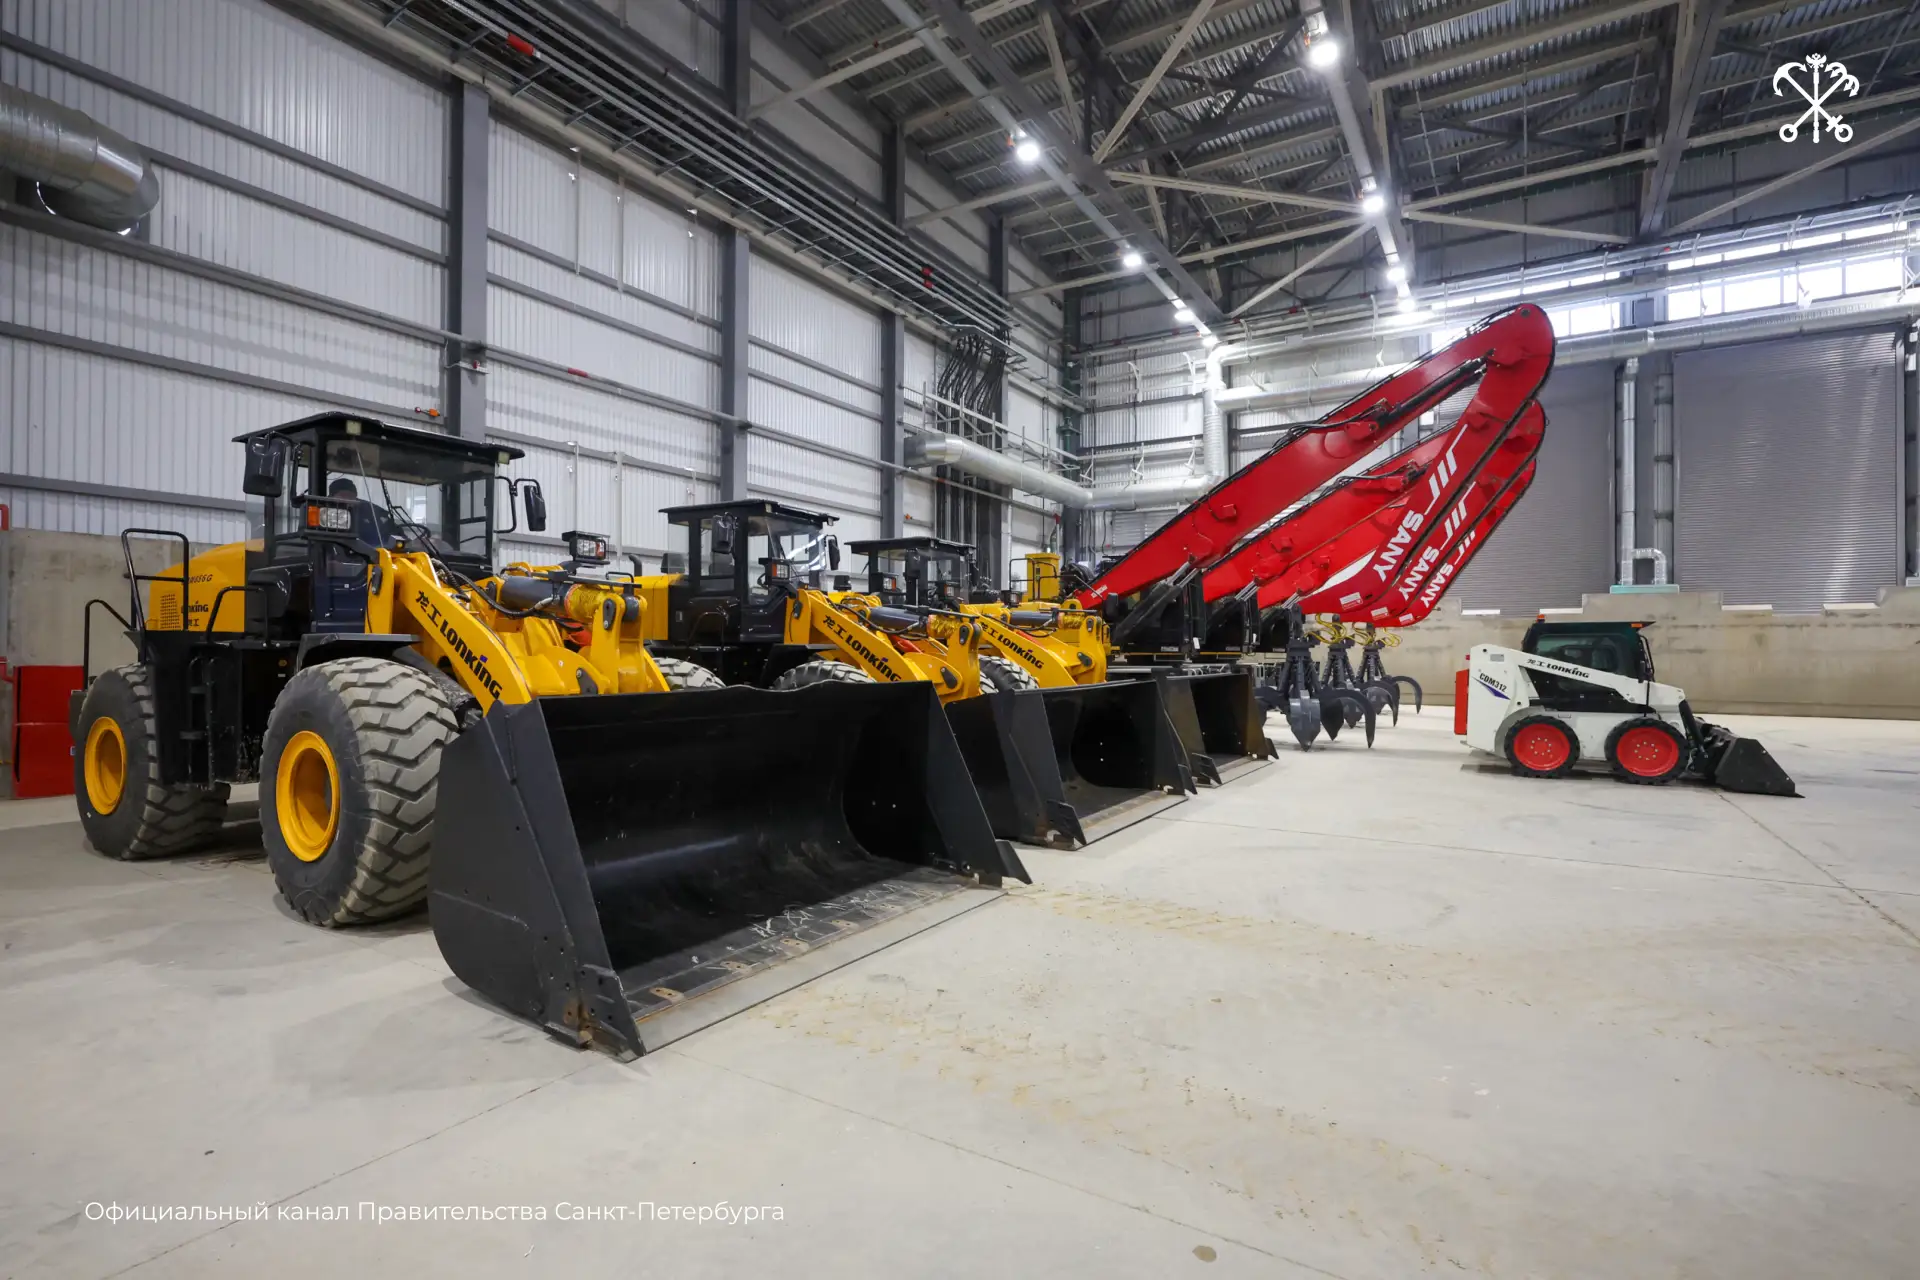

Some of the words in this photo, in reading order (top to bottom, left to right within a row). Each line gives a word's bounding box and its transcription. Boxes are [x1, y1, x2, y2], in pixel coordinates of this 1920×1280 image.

[1373, 509, 1424, 582] SANY
[1398, 545, 1440, 601] SANY
[1420, 562, 1454, 608] SANY
[1479, 672, 1508, 693] CDM312
